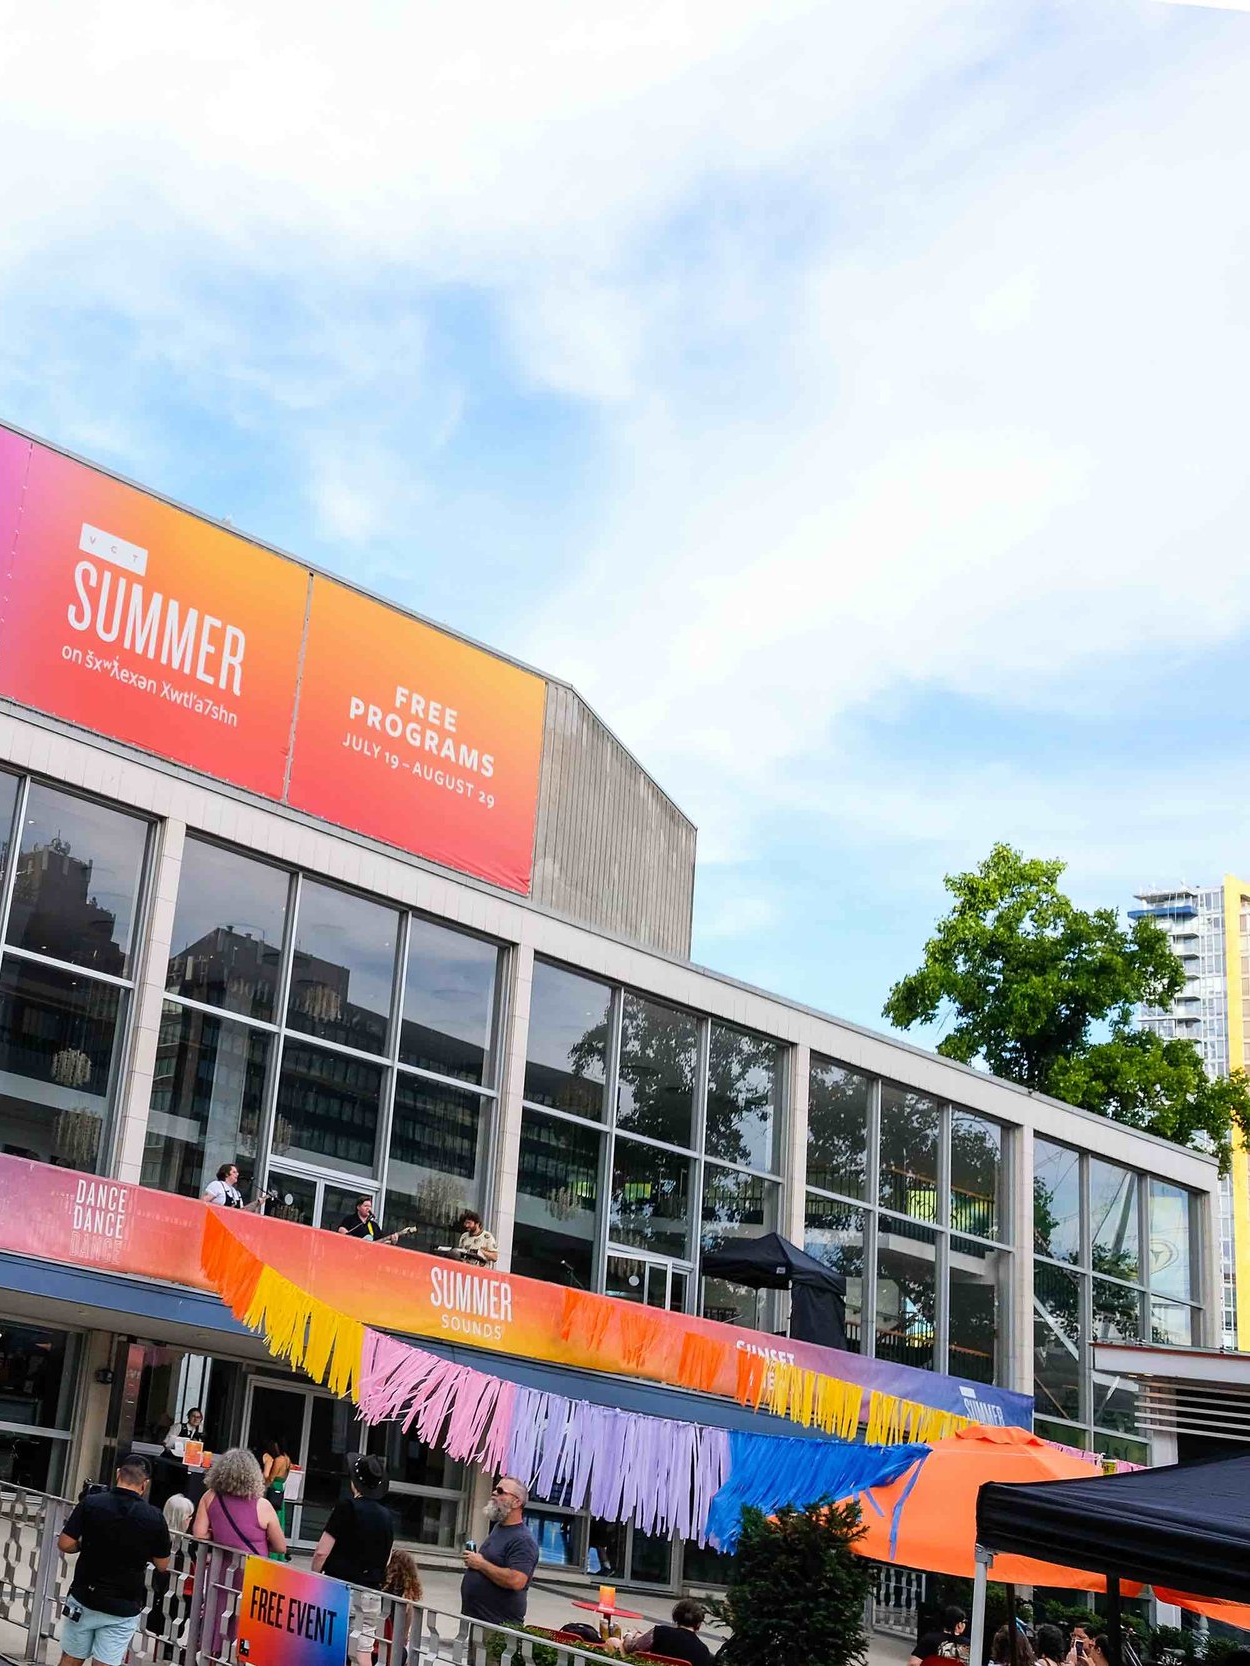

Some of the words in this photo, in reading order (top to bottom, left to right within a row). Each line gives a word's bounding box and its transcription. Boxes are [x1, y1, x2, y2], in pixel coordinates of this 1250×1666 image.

[67, 561, 246, 696] SUMMER
[62, 645, 82, 664] on
[394, 685, 458, 733] FREE
[350, 696, 495, 779] PROGRAMS
[342, 731, 382, 760] JULY
[384, 750, 400, 769] 19
[411, 761, 474, 799] AUGUST
[477, 792, 495, 810] 29
[76, 1179, 127, 1213] DANCE
[73, 1205, 124, 1239] DANCE
[69, 1231, 123, 1265] DANCE
[430, 1267, 513, 1322] SUMMER
[441, 1314, 502, 1341] SOUNDS
[963, 1397, 1006, 1427] SUMMER
[250, 1585, 285, 1630] FREE
[287, 1597, 337, 1647] EVENT
